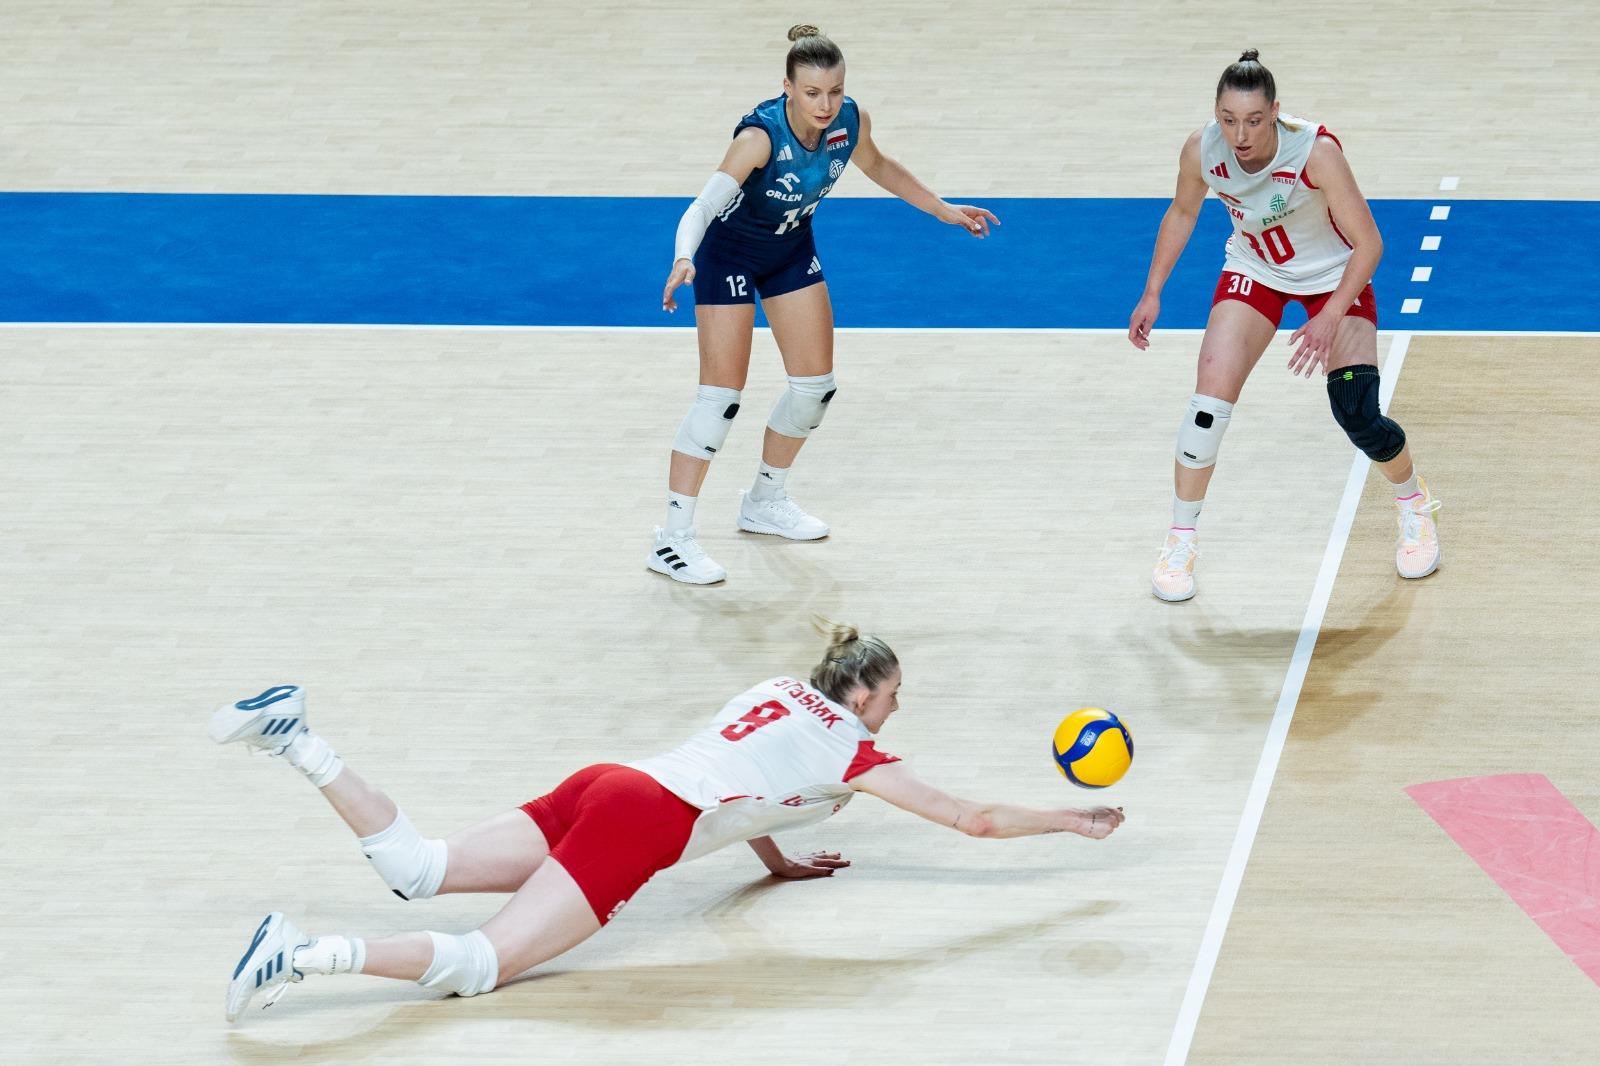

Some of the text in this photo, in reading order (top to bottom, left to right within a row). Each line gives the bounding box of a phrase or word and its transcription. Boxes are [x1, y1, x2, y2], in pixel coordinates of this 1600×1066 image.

[1272, 177, 1295, 186] POLSKA
[765, 189, 803, 202] ORLEN
[1227, 205, 1245, 221] LEN
[1262, 209, 1296, 226] plus
[725, 274, 748, 297] 12
[1227, 274, 1253, 296] 30
[720, 700, 791, 742] 9
